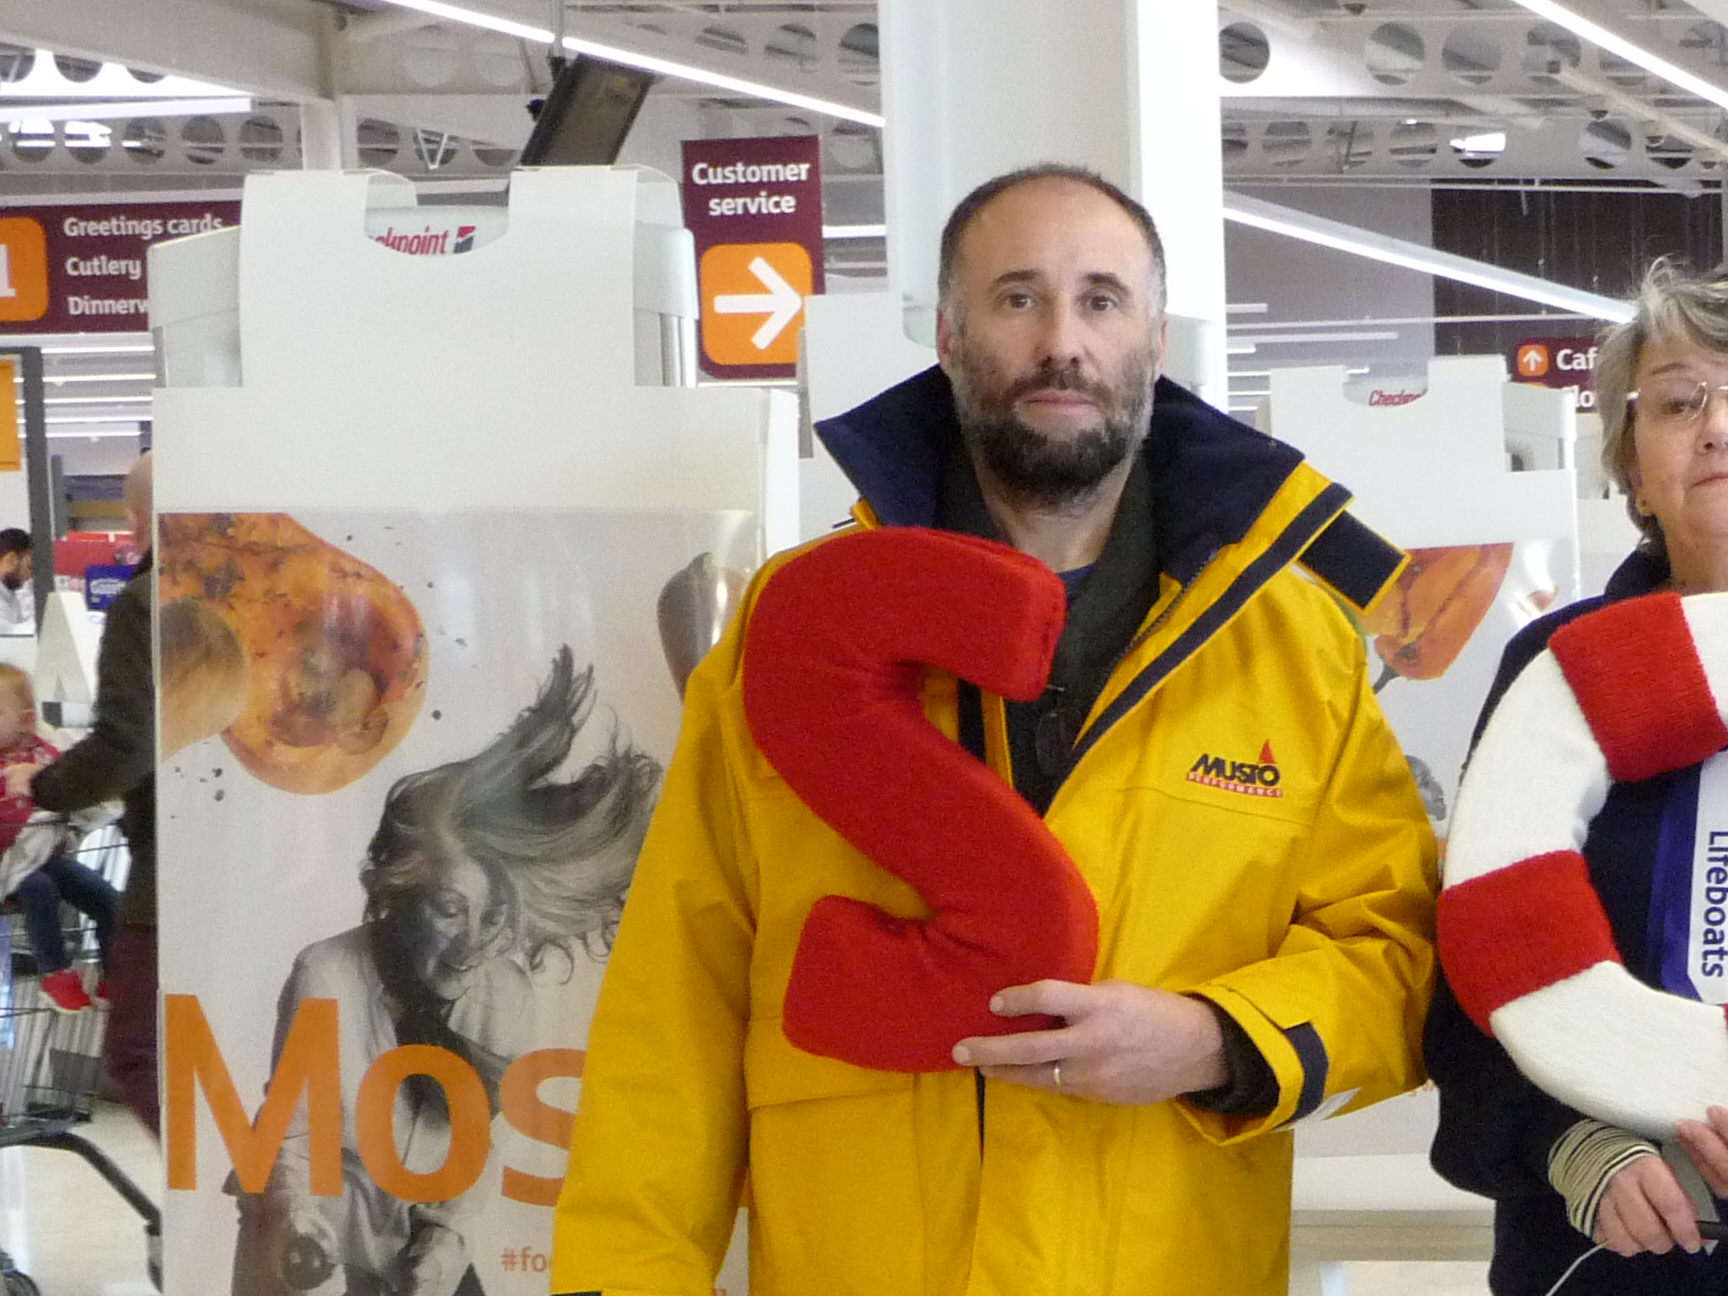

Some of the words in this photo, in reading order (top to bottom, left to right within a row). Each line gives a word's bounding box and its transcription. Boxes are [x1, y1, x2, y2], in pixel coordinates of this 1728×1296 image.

[692, 161, 811, 186] Customer
[708, 192, 797, 217] service
[63, 215, 163, 240] Greetings
[166, 213, 223, 234] cards
[65, 255, 142, 280] Cutlery
[1189, 753, 1281, 787] MUSTO
[162, 994, 590, 1207] Mos
